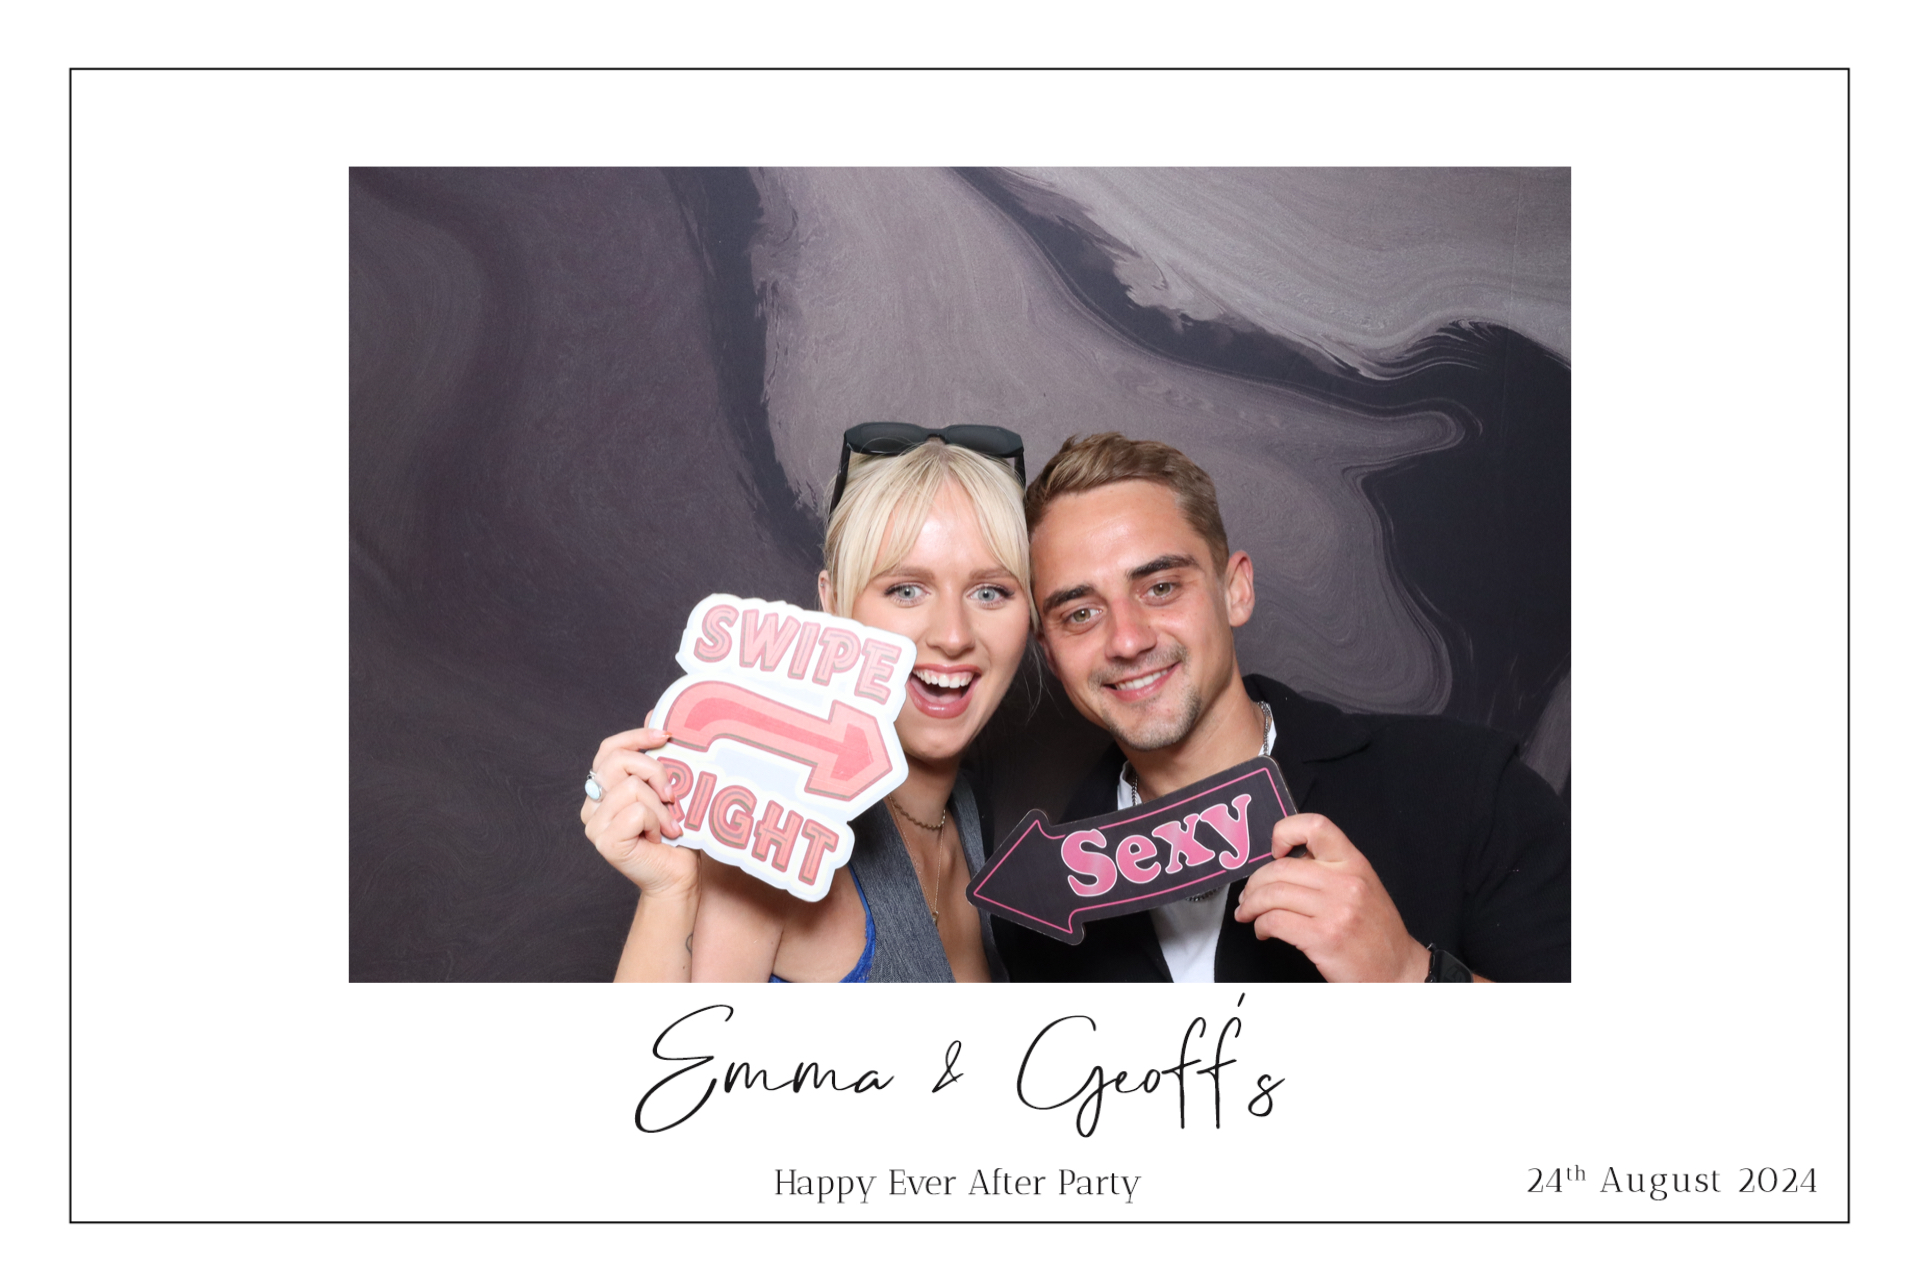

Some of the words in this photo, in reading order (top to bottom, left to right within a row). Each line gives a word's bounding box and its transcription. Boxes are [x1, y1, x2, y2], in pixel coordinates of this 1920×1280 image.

[694, 604, 902, 705] SWIPE
[657, 757, 839, 886] RIGHT
[1061, 794, 1252, 897] Sexy
